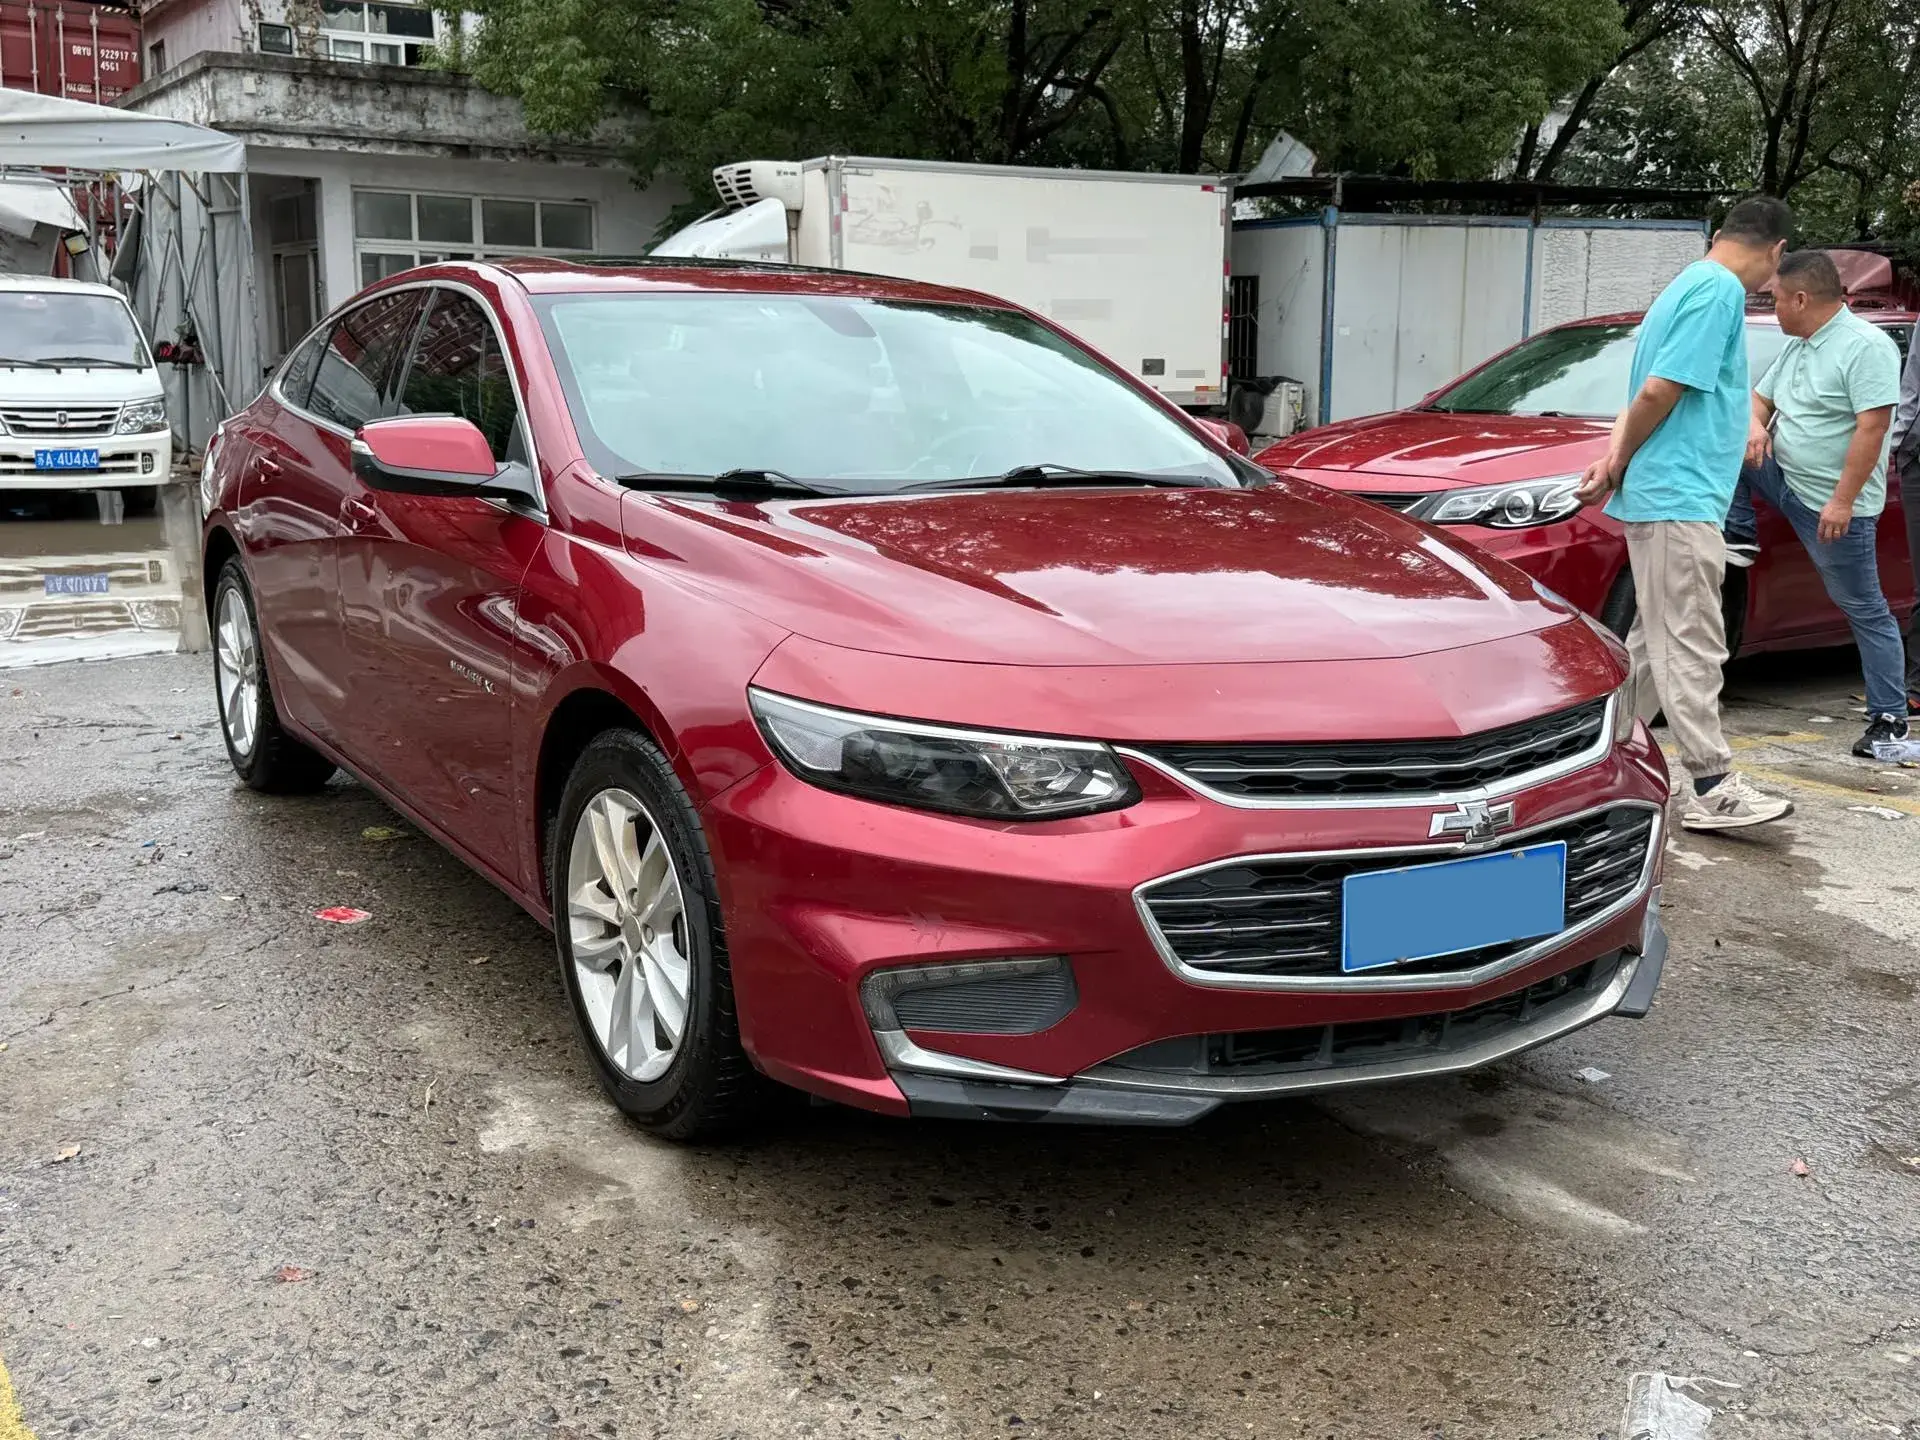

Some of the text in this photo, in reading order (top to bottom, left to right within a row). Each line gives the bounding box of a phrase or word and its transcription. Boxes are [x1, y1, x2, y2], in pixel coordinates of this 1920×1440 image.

[100, 48, 129, 61] 922917
[131, 51, 138, 63] 7
[100, 60, 120, 72] 45G1
